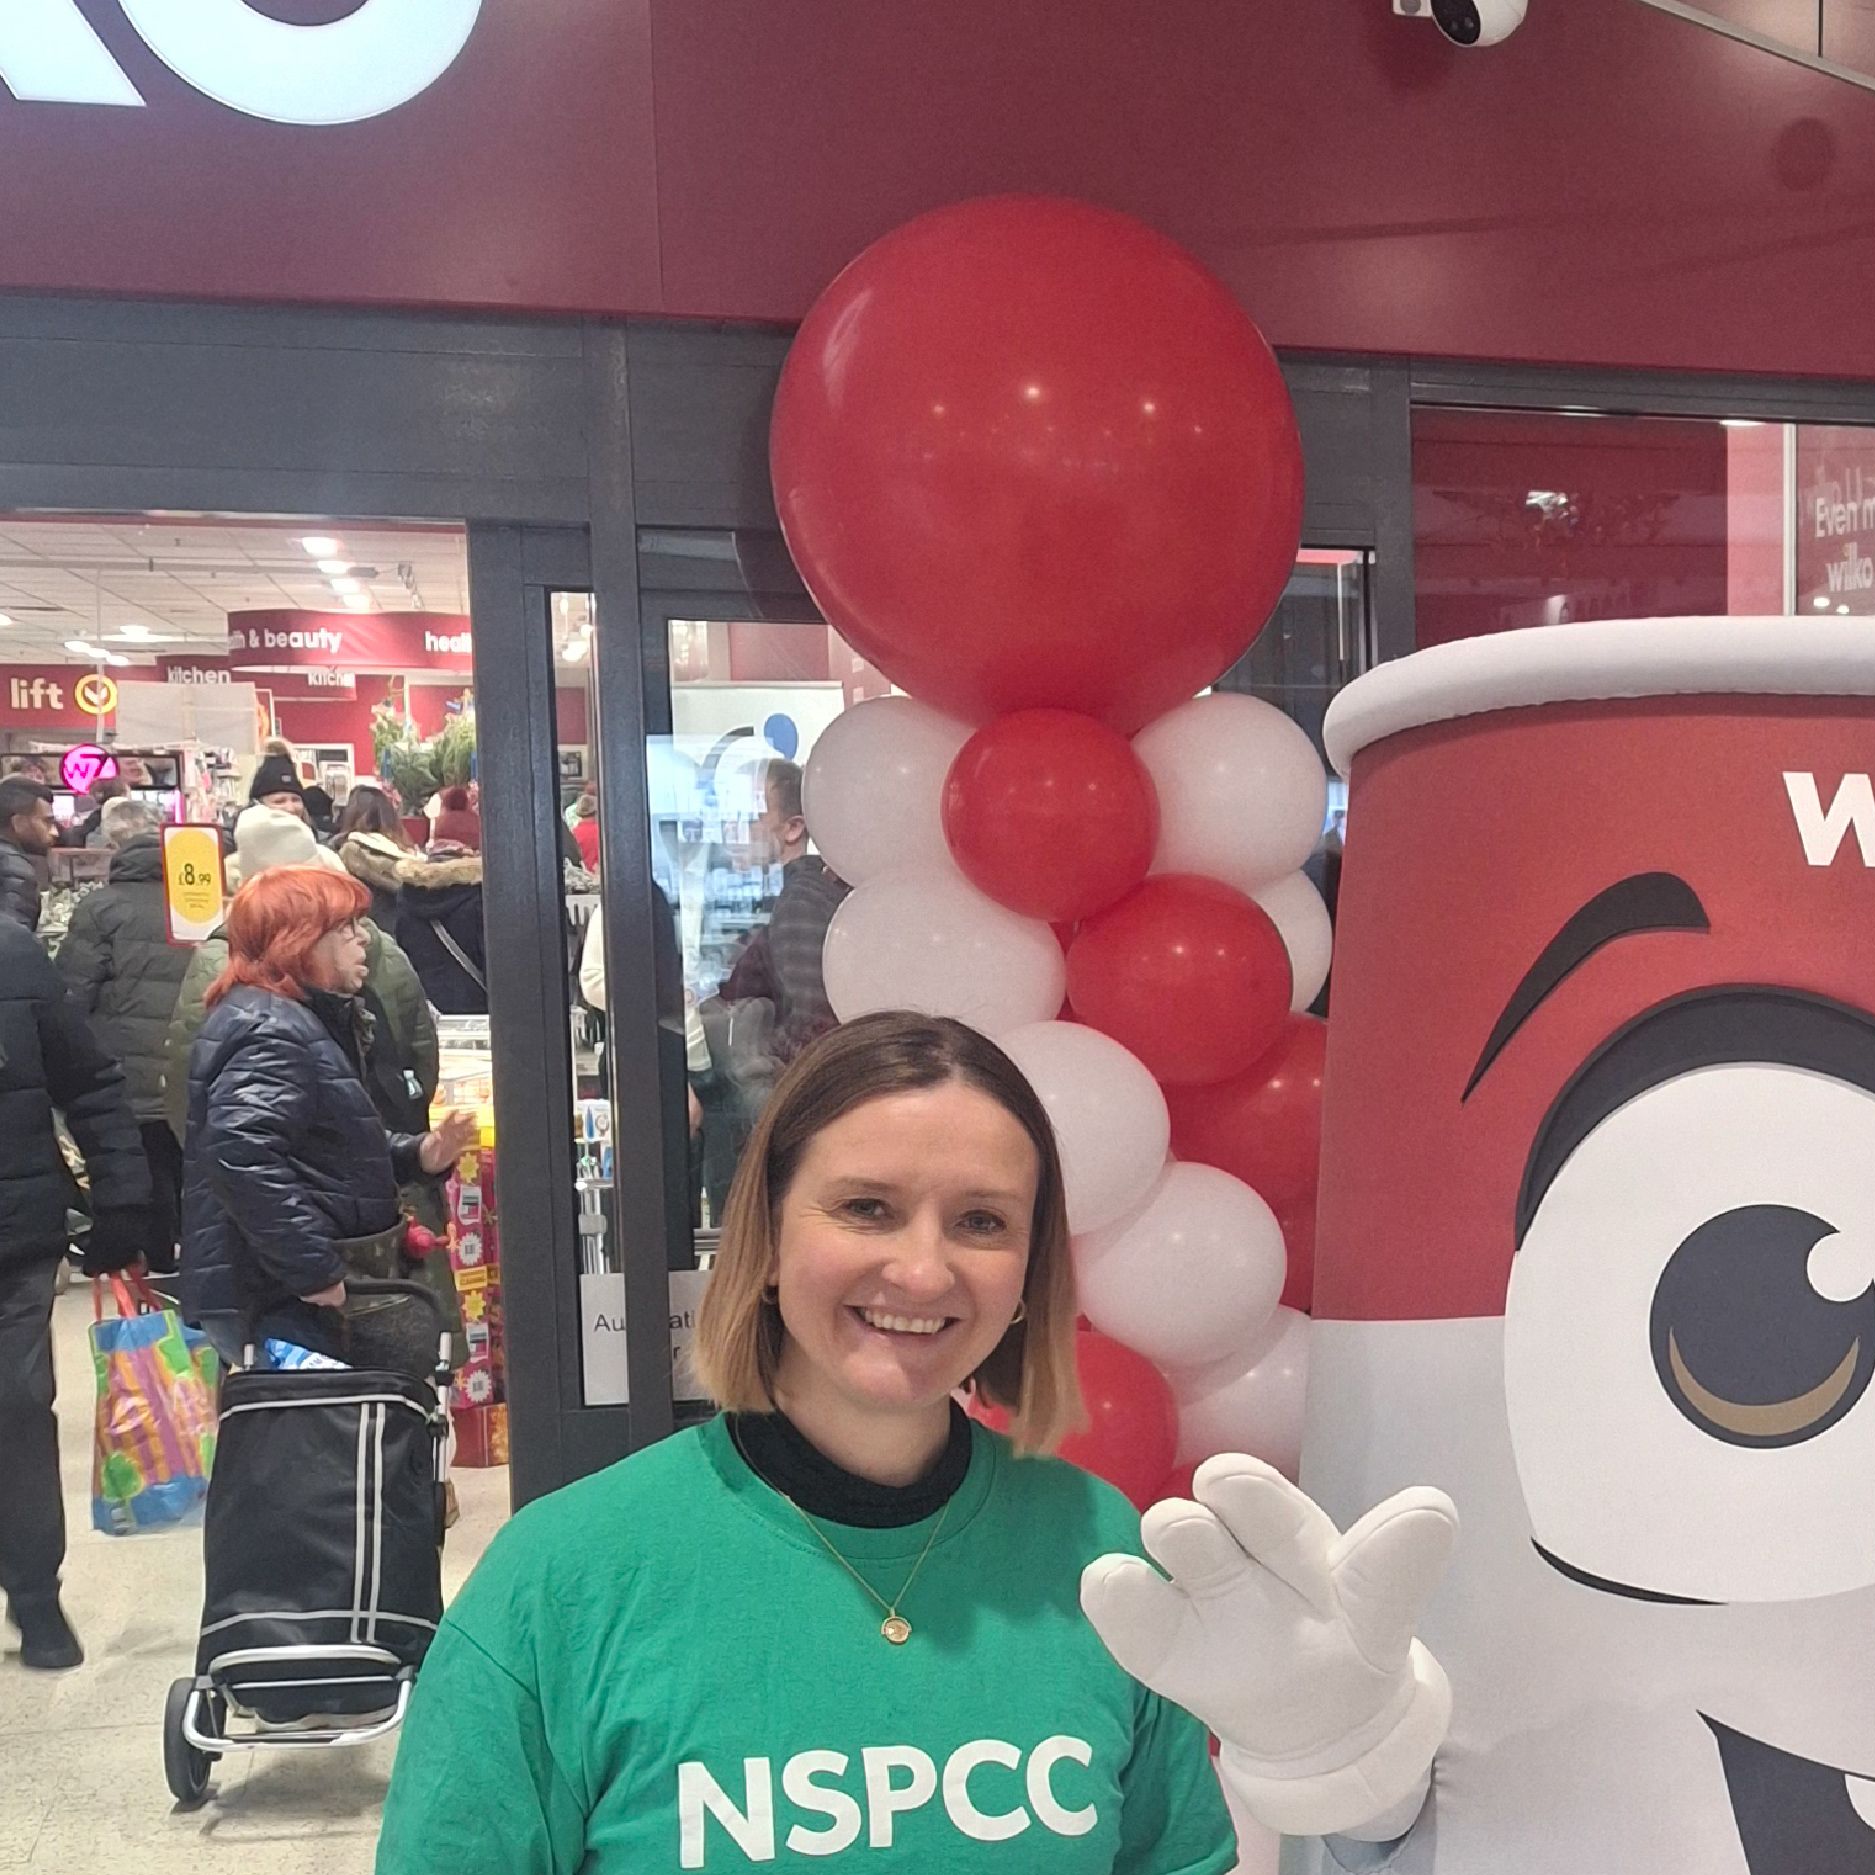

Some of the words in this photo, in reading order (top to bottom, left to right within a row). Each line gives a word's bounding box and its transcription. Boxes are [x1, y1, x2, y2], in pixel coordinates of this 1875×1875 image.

[1815, 497, 1858, 538] Even
[1825, 541, 1874, 592] wilko
[264, 627, 343, 654] beauty
[10, 677, 64, 710] lift
[167, 665, 232, 685] kitchen
[678, 1735, 1098, 1869] NSPCC
